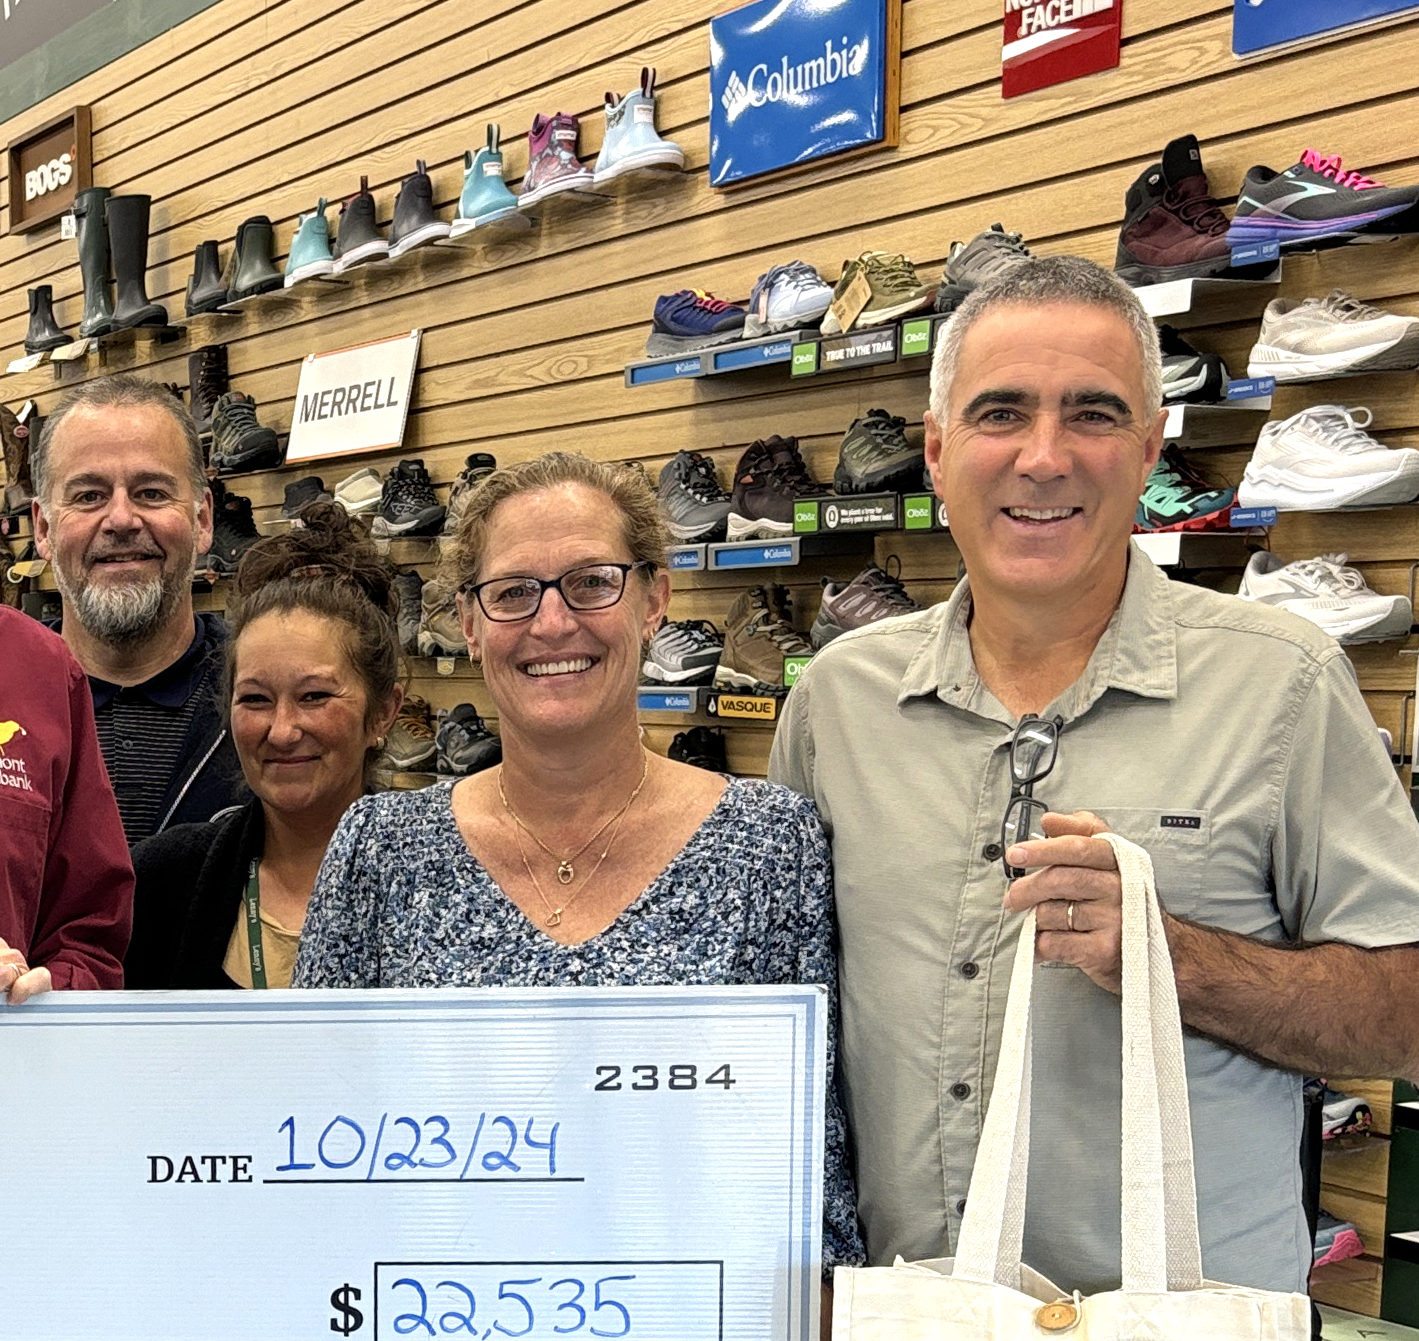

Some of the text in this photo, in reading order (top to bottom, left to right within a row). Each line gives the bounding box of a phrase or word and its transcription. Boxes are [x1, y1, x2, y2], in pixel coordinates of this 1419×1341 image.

[1020, 2, 1074, 37] FACE
[747, 36, 866, 107] Columbia
[25, 153, 72, 201] BOGS
[826, 348, 845, 361] TRUE
[846, 347, 856, 358] TO
[856, 344, 870, 357] THE
[299, 376, 398, 424] MERRELL
[721, 700, 772, 713] VASQUE
[594, 1064, 738, 1091] 2384
[147, 1155, 254, 1184] DATE
[275, 1112, 561, 1180] 10/23/24
[329, 1284, 364, 1337] $
[391, 1275, 637, 1341] 22,535
